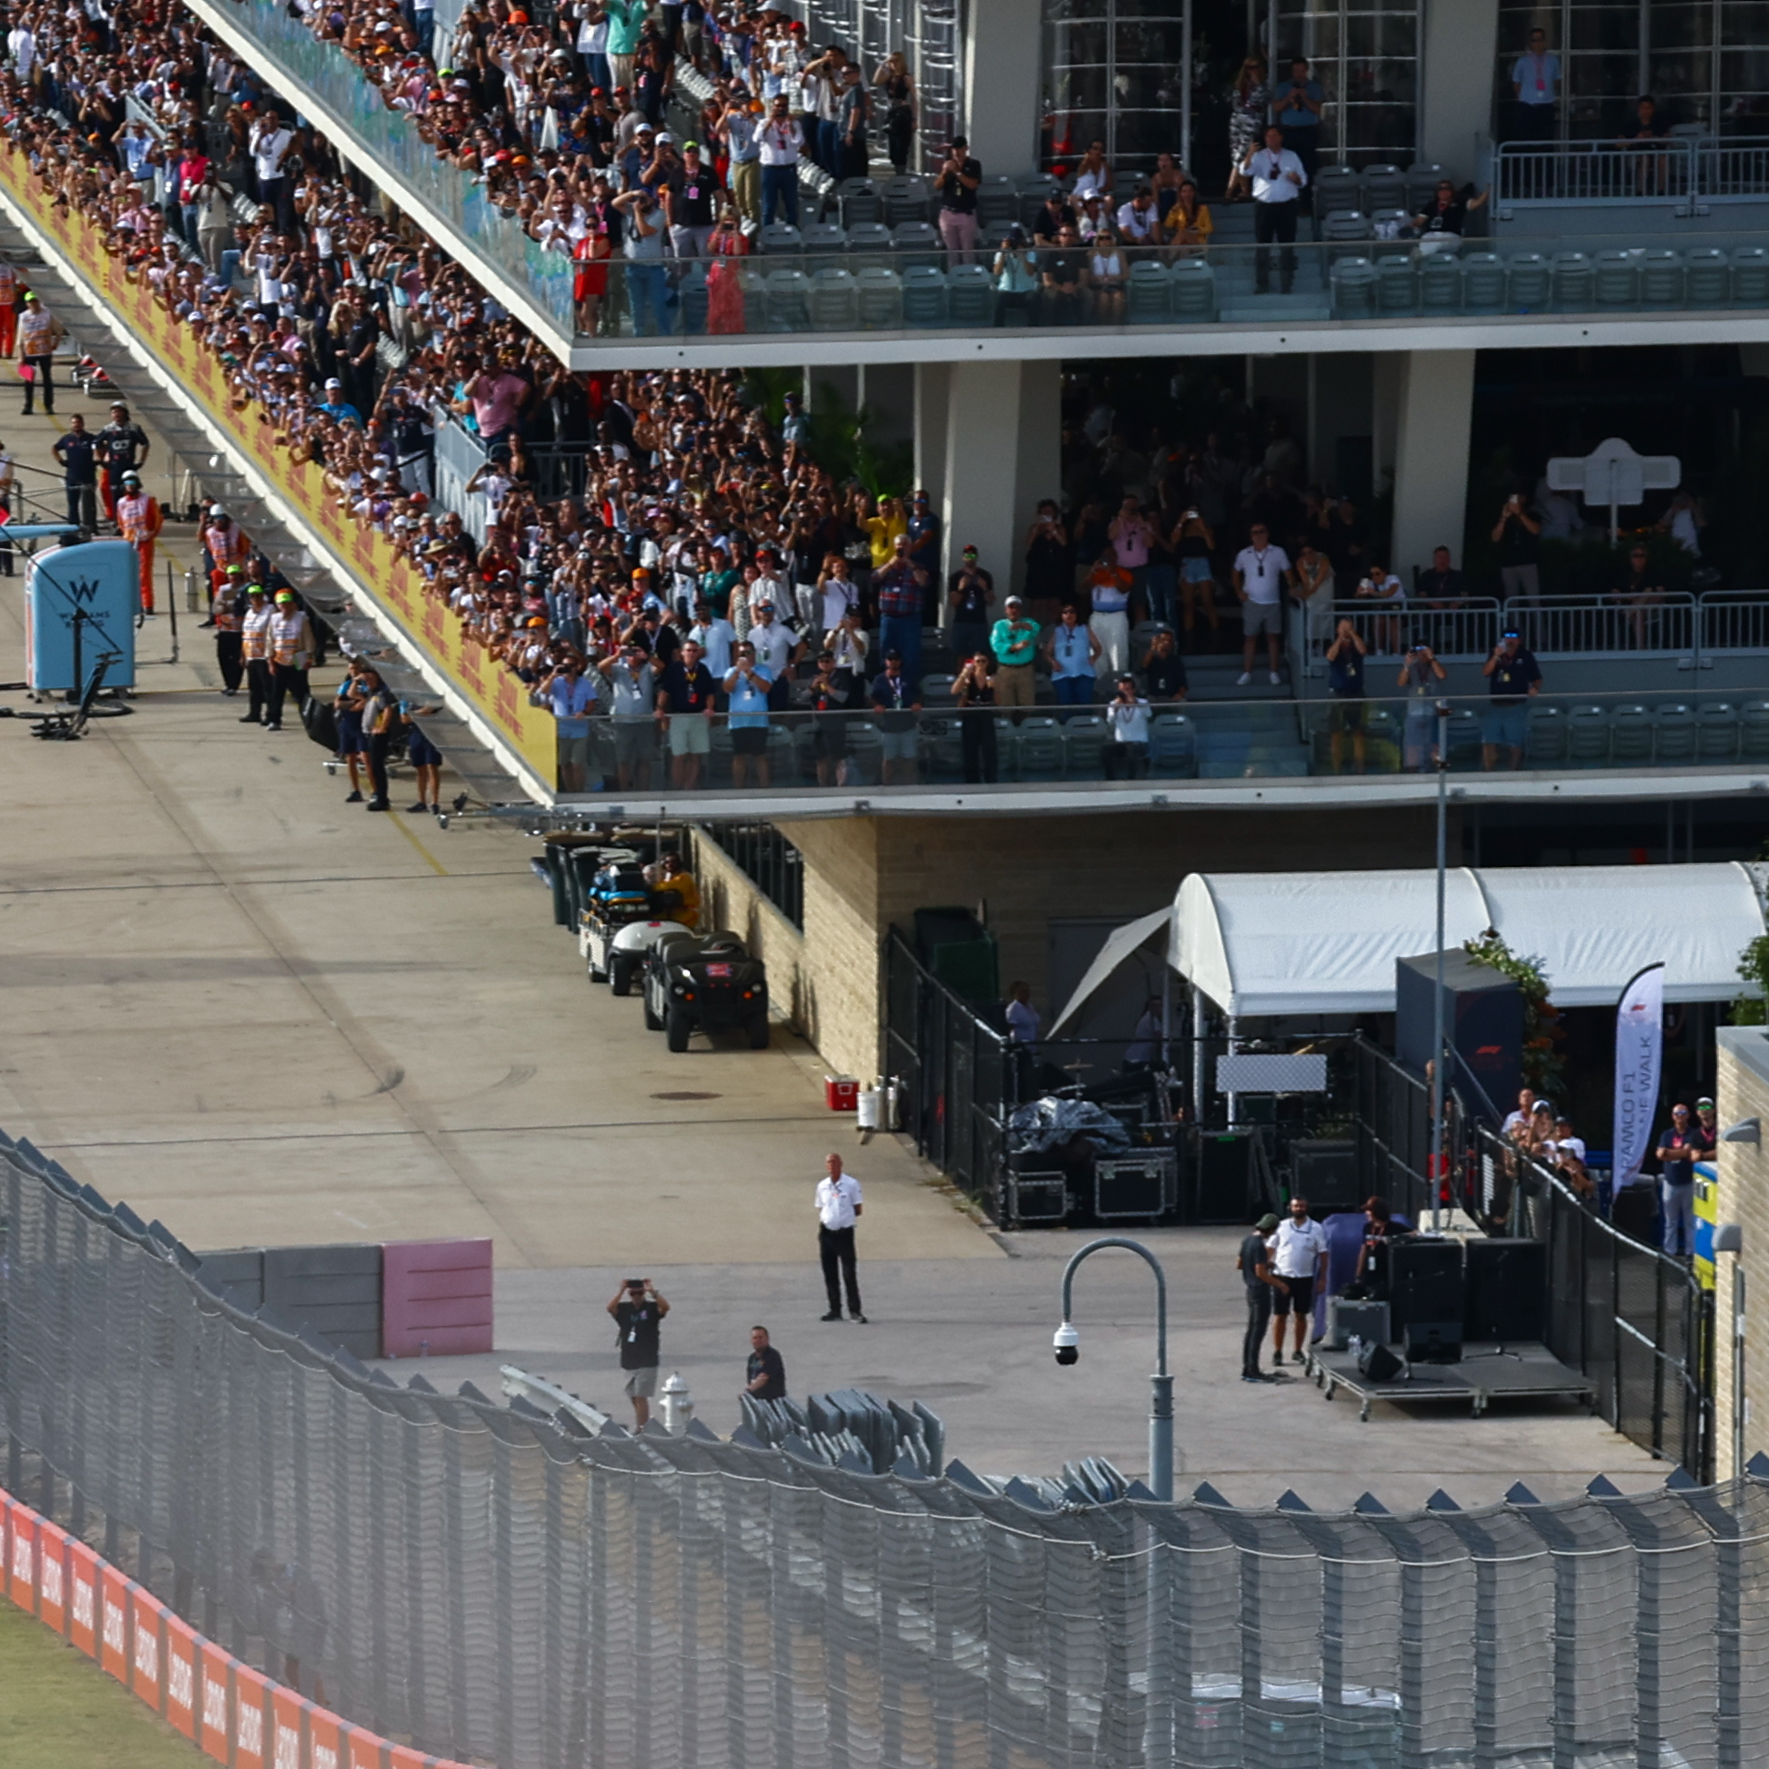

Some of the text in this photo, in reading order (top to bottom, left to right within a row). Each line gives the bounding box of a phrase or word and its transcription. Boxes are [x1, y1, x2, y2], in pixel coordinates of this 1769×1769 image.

[59, 611, 110, 619] WIAMS
[1638, 1036, 1652, 1092] WALK
[1620, 1098, 1636, 1170] RAMCO
